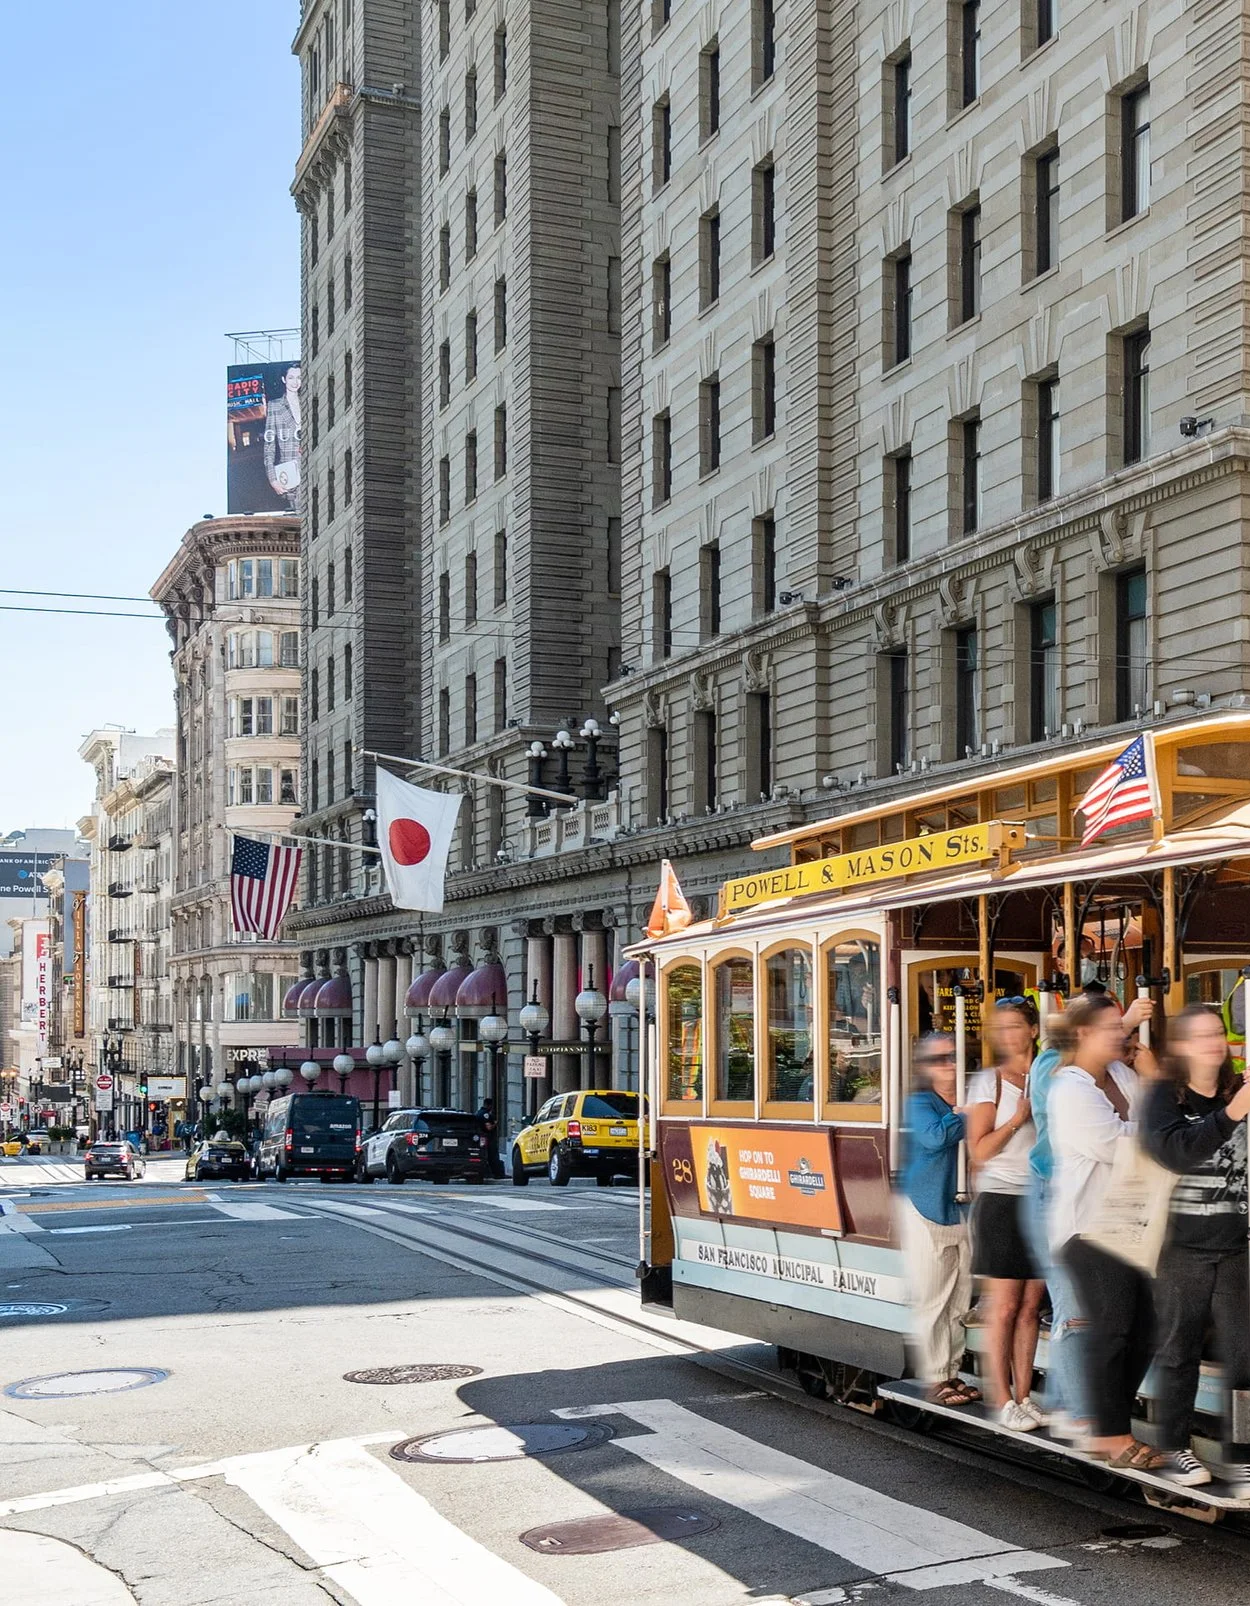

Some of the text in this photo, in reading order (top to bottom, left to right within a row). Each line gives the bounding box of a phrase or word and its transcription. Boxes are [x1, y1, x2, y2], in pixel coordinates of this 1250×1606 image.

[228, 380, 259, 391] RADIO
[228, 388, 259, 398] CITY
[264, 428, 302, 442] GUC
[732, 832, 985, 902] POWELL & MASON Sts.
[13, 884, 41, 893] Powell
[937, 987, 954, 997] FARE
[39, 963, 47, 1042] HERBERT
[226, 1048, 266, 1061] EXPRE
[738, 1149, 774, 1165] HOP ON TO
[672, 1158, 693, 1184] 28
[738, 1167, 782, 1183] GHIRARDELLI
[748, 1186, 777, 1200] SQUARE
[698, 1244, 877, 1296] SAN FRANCISCO MUNICIPAL RAILWAY
